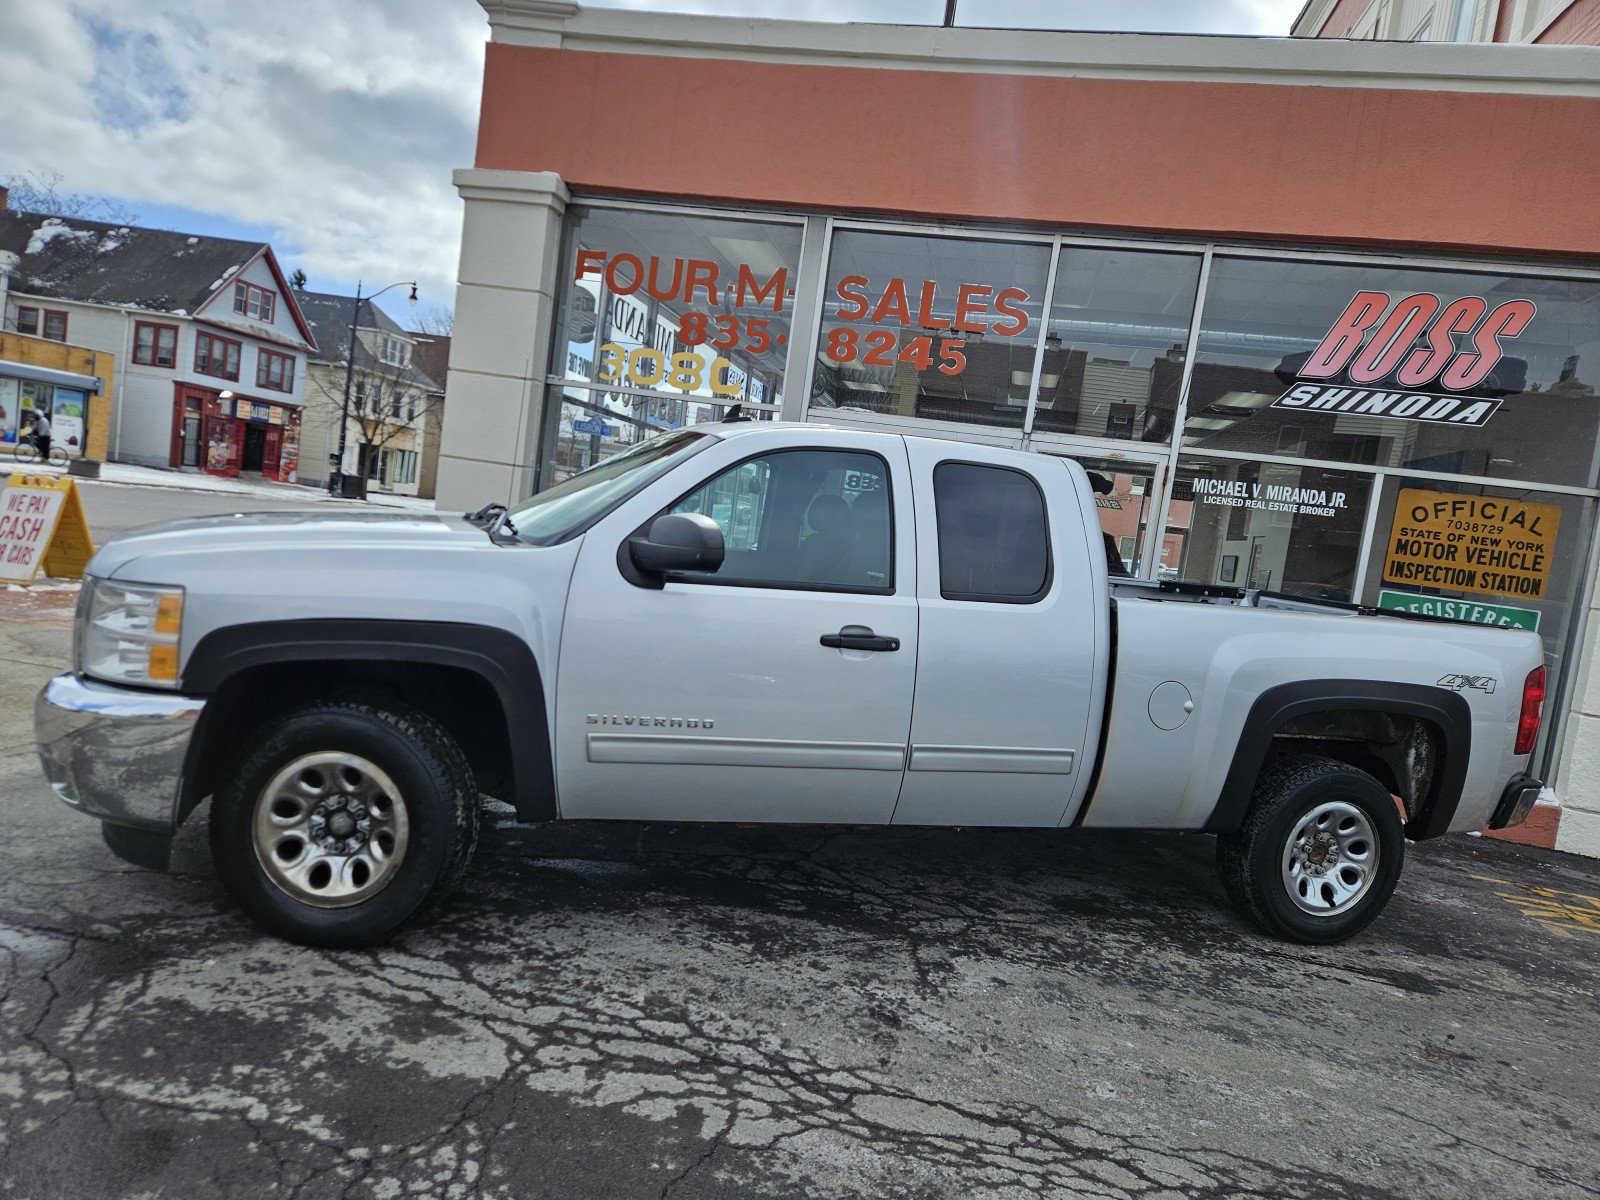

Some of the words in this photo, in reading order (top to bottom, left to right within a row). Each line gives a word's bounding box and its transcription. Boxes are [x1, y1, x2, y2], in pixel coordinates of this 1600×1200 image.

[835, 275, 1030, 337] SALES
[826, 328, 967, 376] 8245
[1296, 290, 1537, 391] BOSS
[1281, 385, 1493, 424] SHINODA
[7, 494, 28, 512] WE
[26, 495, 51, 514] PAY
[1192, 478, 1249, 498] MICHAEL
[1252, 483, 1262, 499] V.
[1266, 485, 1327, 506] MIRANDA
[1328, 491, 1348, 509] JR.
[1203, 496, 1244, 507] LICENSED
[1245, 500, 1267, 510] REAL
[1268, 502, 1298, 513] ESTATE
[1300, 505, 1336, 517] BROKER
[0, 515, 45, 542] CASH
[1411, 500, 1543, 537] OFFICIAL
[1446, 519, 1504, 535] 7038729
[1394, 538, 1458, 562] MOTOR
[1465, 546, 1545, 572] VEHICLE
[1400, 527, 1442, 541] STATE
[1447, 532, 1466, 543] OF
[1470, 536, 1502, 547] NEW
[1507, 539, 1545, 553] YORK
[1388, 560, 1477, 587] INSPECTION
[1479, 571, 1542, 596] STATION
[586, 713, 715, 729] SILVERADO
